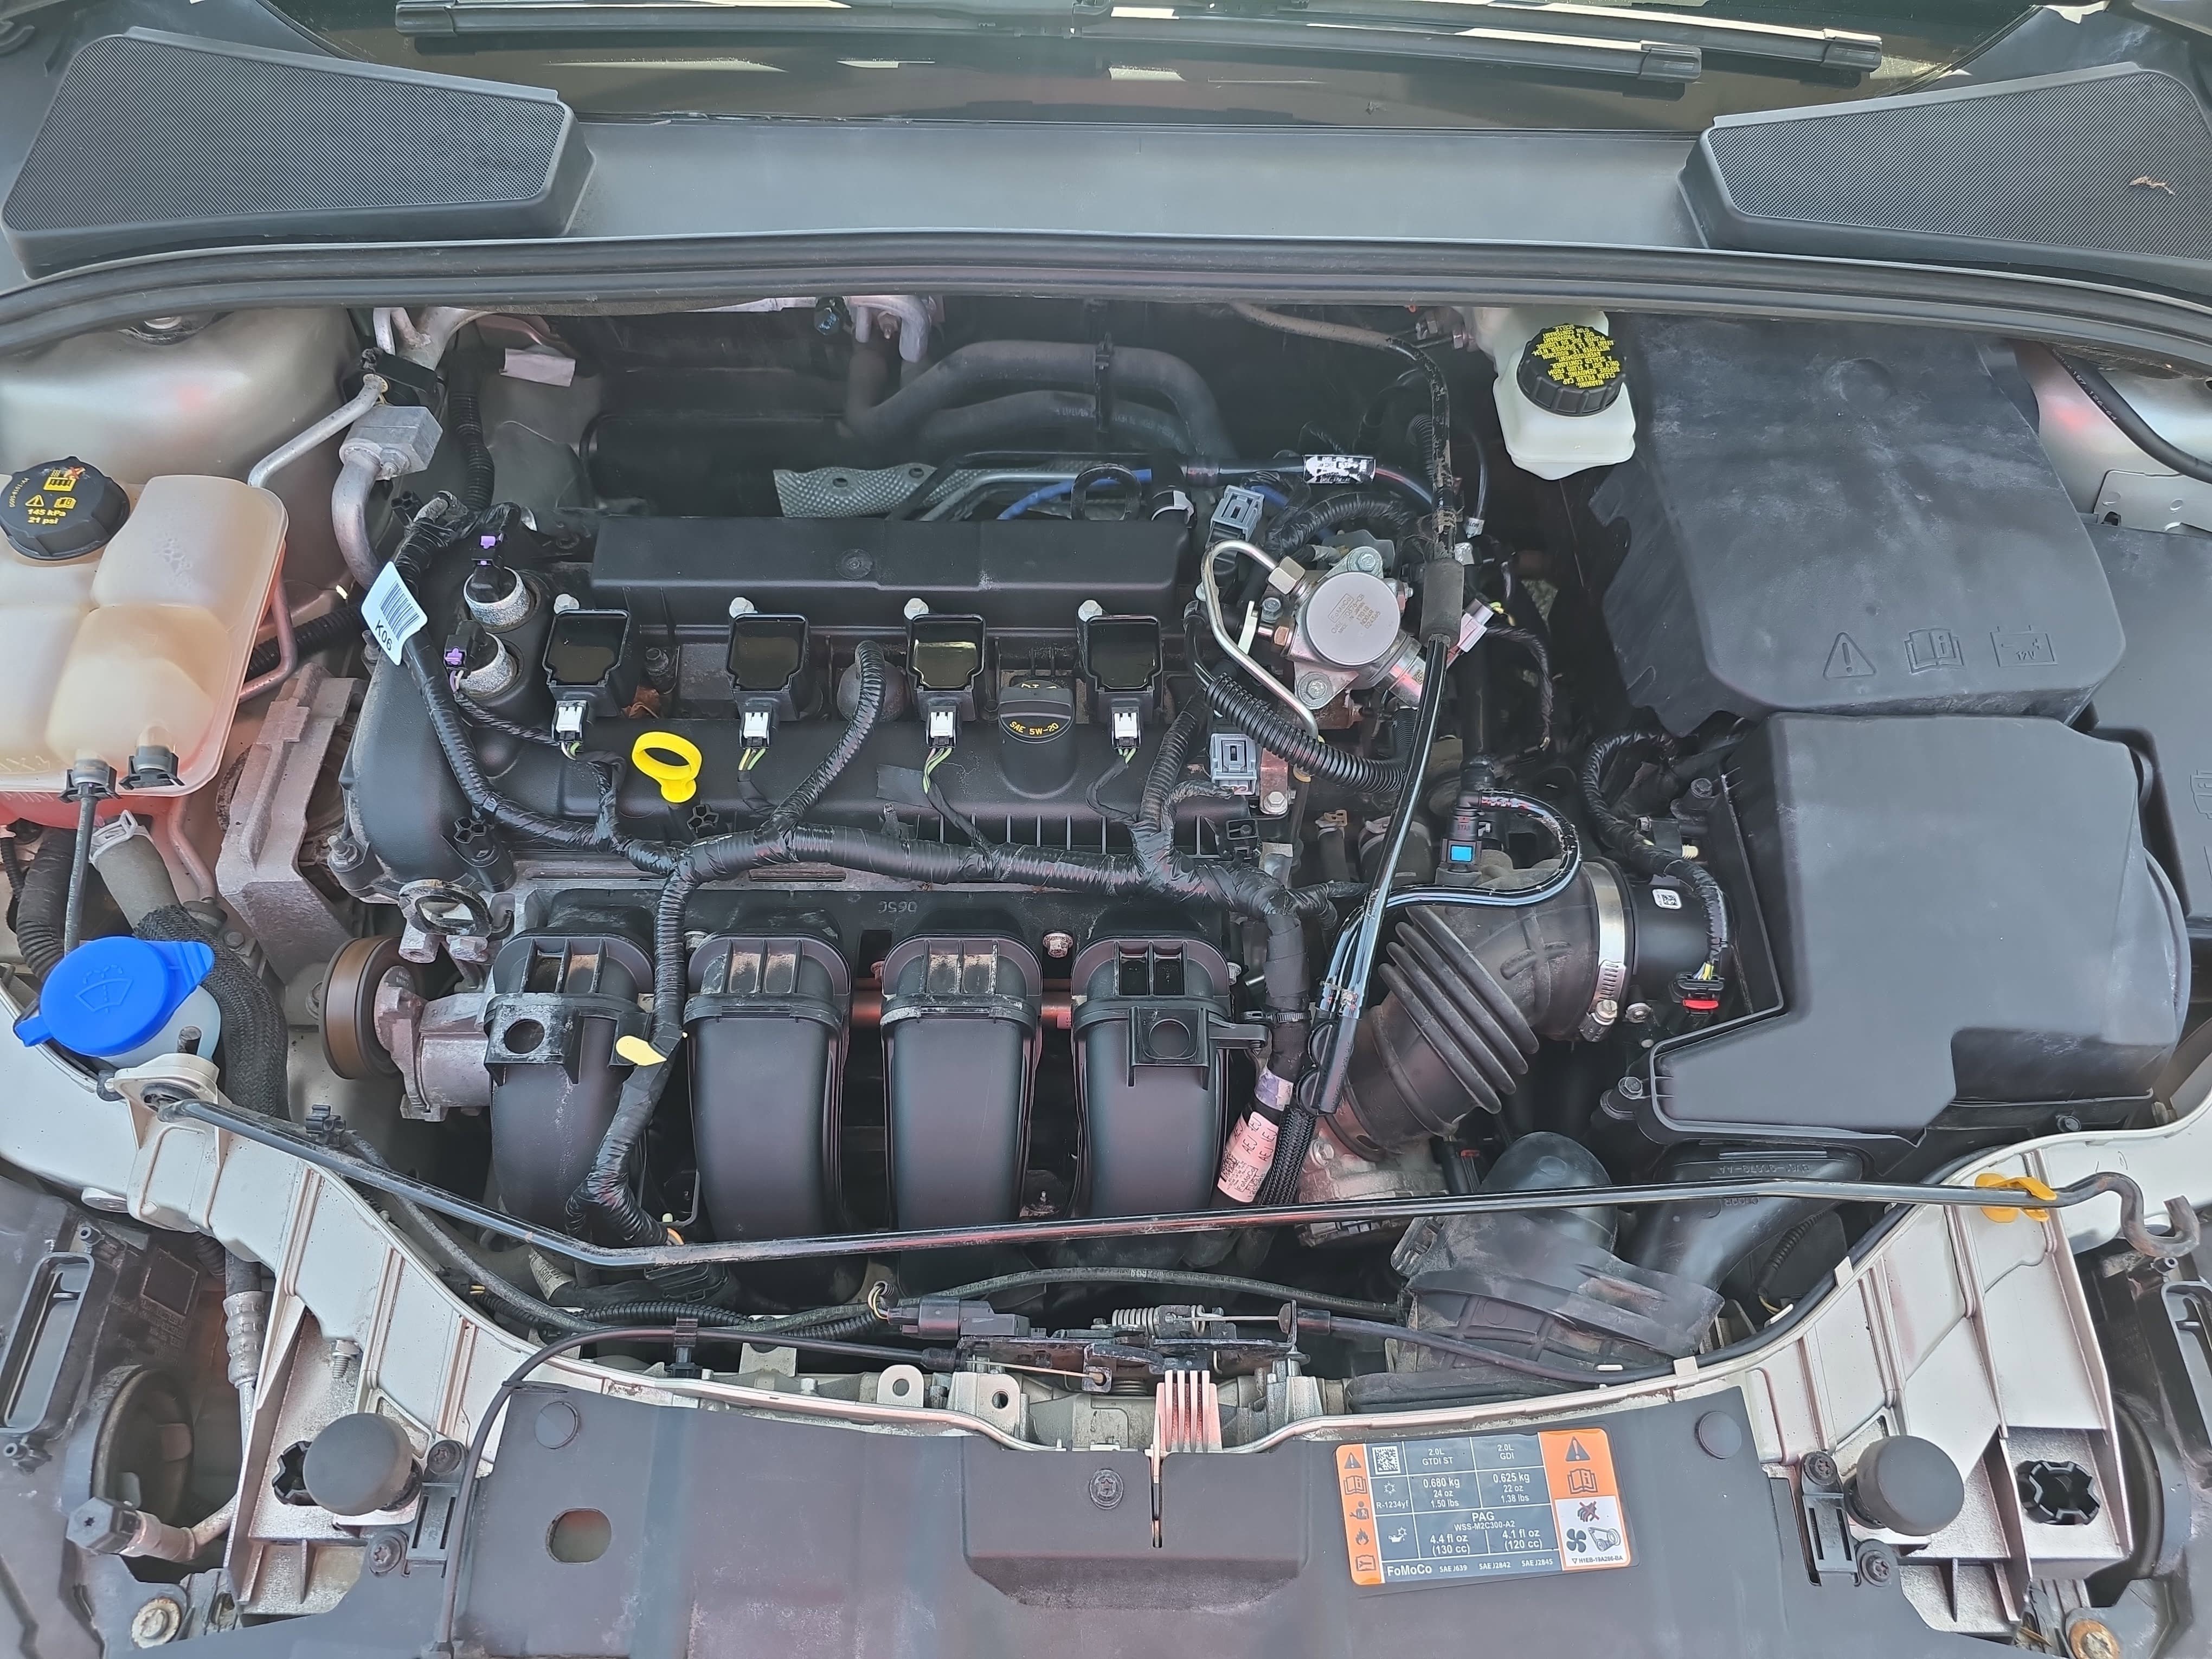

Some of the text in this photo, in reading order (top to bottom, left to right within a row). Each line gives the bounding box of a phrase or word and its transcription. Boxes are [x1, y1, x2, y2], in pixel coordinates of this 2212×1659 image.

[1542, 329, 1574, 338] CONTENANT
[1543, 333, 1575, 343] PROVENANT
[1536, 342, 1559, 350] LIQUIDE
[1542, 351, 1569, 359] BOUCHON
[1576, 380, 1604, 388] WARNING:
[1331, 597, 1351, 619] FoMoCo
[375, 619, 393, 651] K06
[1009, 721, 1059, 735] SAE 5W-20
[1233, 1120, 1243, 1141] AEJ
[1242, 1135, 1257, 1155] AEJ
[1258, 1147, 1274, 1162] AEJ
[1237, 1168, 1255, 1191] FoMoCo
[1423, 1477, 1460, 1488] 0.680 kg
[1493, 1472, 1530, 1483] 0.625 kg
[1433, 1489, 1442, 1497] 24
[1503, 1484, 1513, 1493] 22
[1431, 1500, 1446, 1508] 1.50
[1501, 1494, 1529, 1503] 1.38 lbs
[1376, 1500, 1409, 1509] R-1234yf
[1471, 1512, 1495, 1522] PAG
[1454, 1520, 1515, 1531] WSS-M2C300-A2
[1430, 1534, 1444, 1545] 4.4
[1447, 1534, 1453, 1542] fl
[1502, 1529, 1516, 1539] 4.1
[1519, 1529, 1525, 1538] fl
[1432, 1543, 1470, 1557] (130 cc)
[1504, 1539, 1542, 1552] (120 cc)
[1387, 1564, 1432, 1577] FoMoCo
